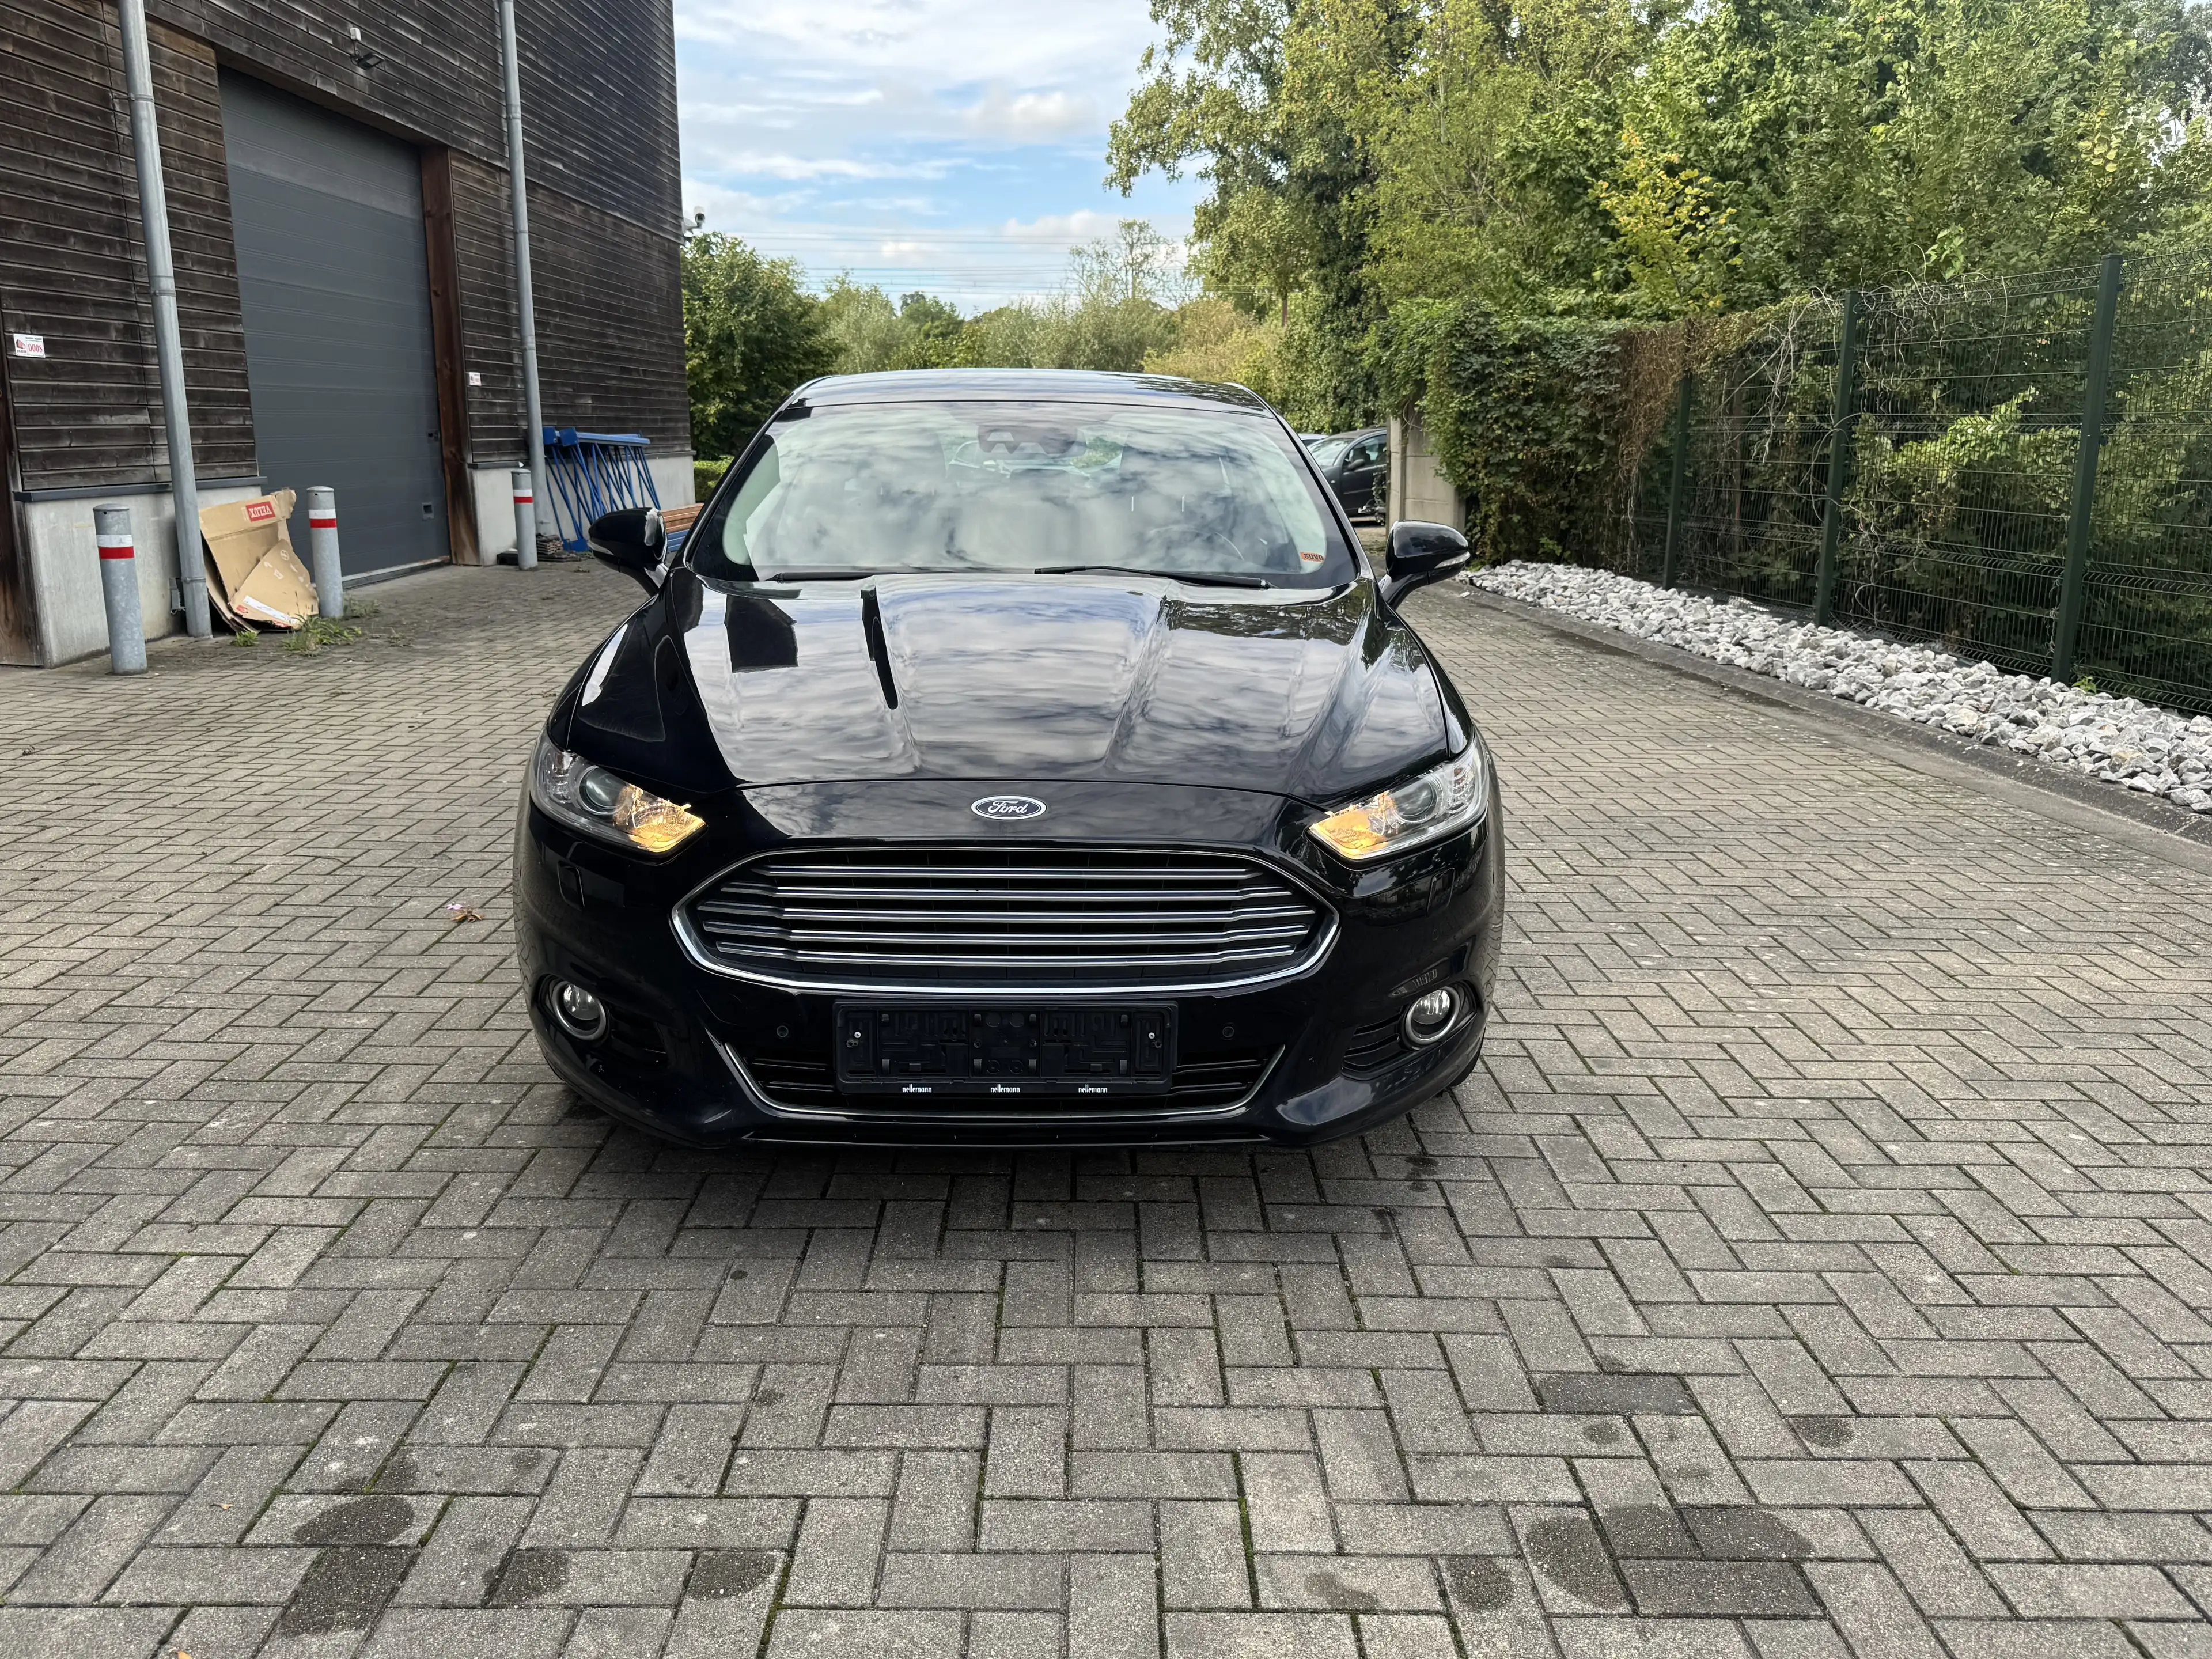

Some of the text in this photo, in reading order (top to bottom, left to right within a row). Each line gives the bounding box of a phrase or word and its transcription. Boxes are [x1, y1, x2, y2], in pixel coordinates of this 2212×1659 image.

[248, 505, 272, 518] VELUX
[987, 800, 1029, 813] Ford
[902, 1084, 932, 1093] nellemann
[990, 1084, 1020, 1093] nellemann
[1078, 1084, 1108, 1093] nellemann
